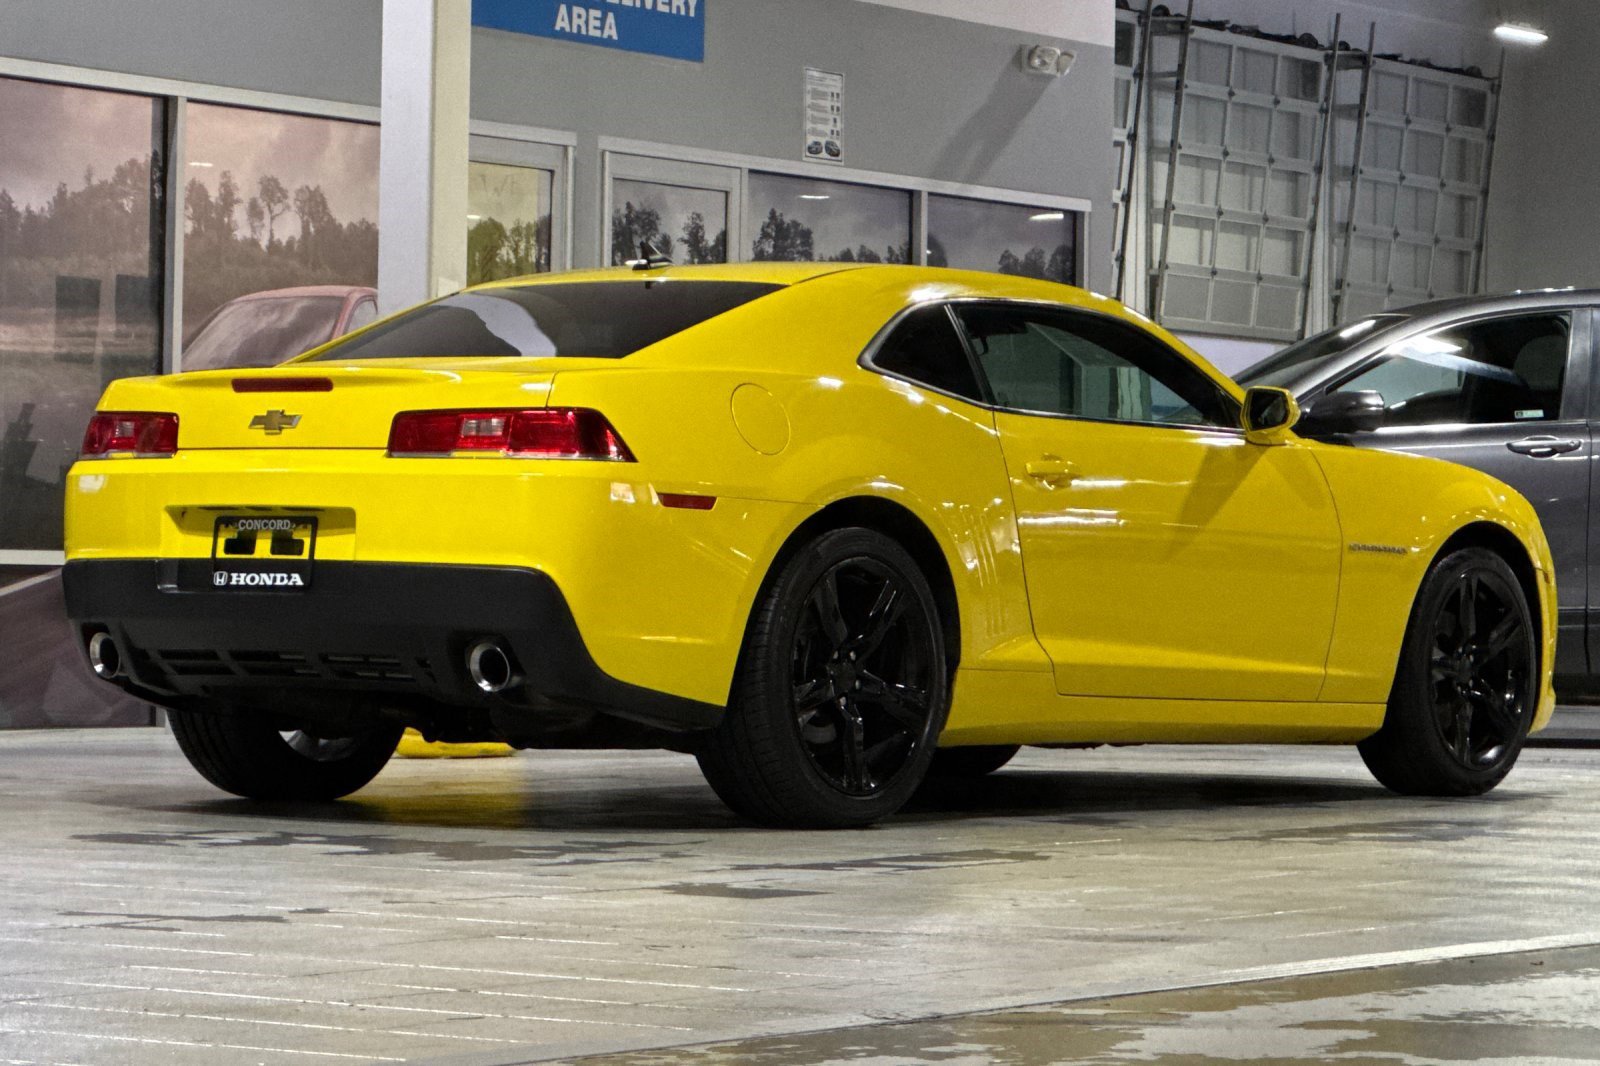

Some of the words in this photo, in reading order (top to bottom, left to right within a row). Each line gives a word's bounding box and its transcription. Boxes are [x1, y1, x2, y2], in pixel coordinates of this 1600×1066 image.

[554, 4, 618, 40] AREA
[239, 519, 291, 531] CONCORD
[229, 572, 304, 586] HONDA
